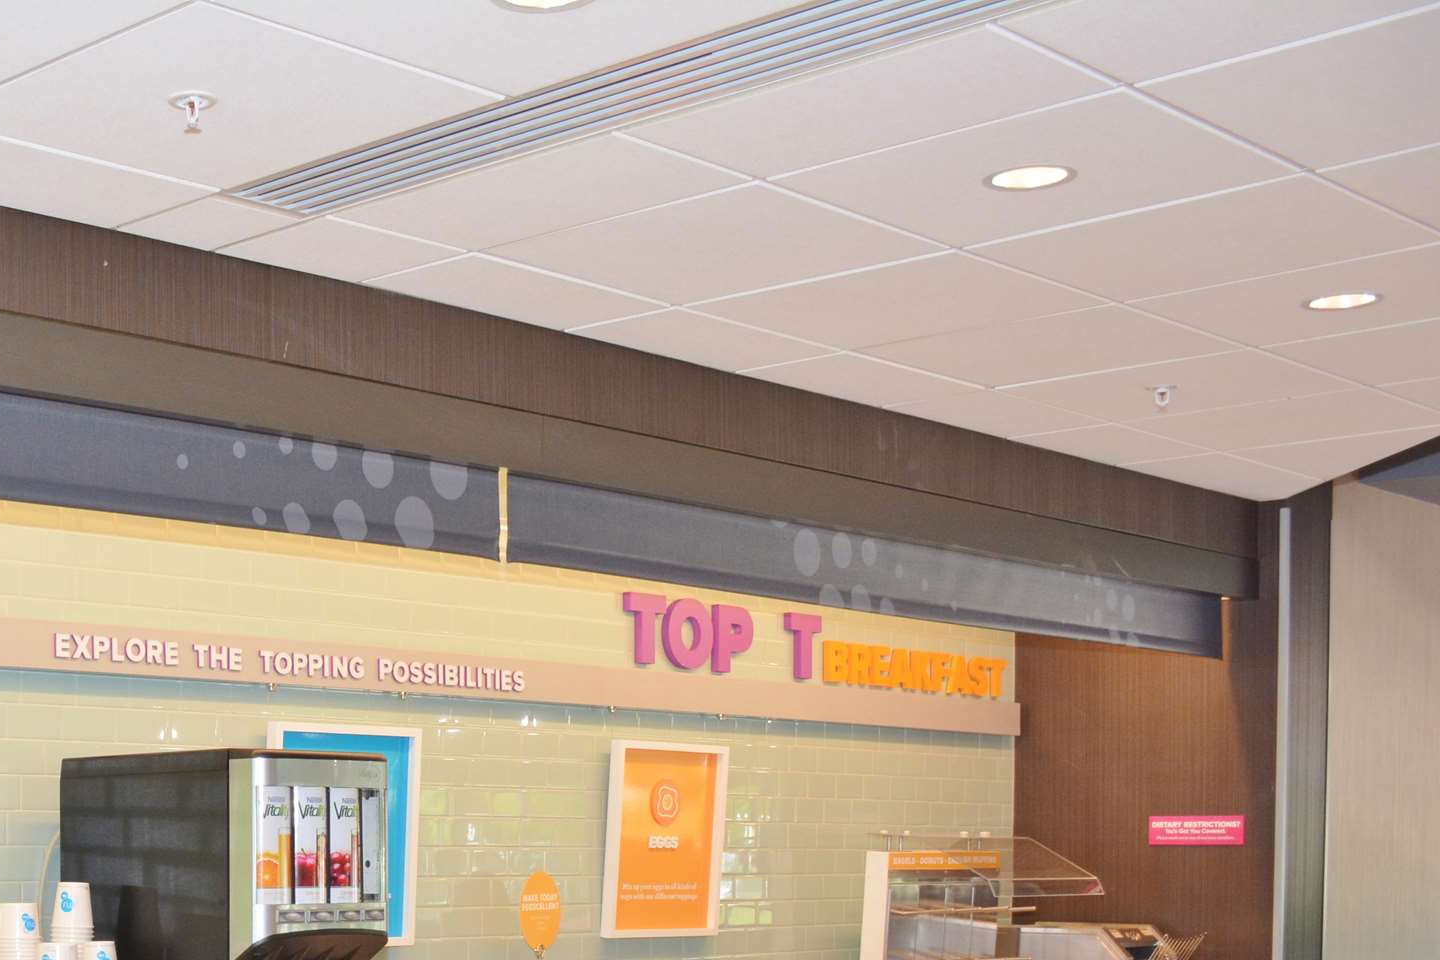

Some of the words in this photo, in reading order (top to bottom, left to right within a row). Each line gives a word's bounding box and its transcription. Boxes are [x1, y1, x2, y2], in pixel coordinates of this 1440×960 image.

[54, 632, 179, 666] EXPLORE
[193, 644, 242, 671] THE
[260, 650, 365, 680] TOPPING
[378, 656, 525, 692] POSSIBILITIES
[623, 592, 754, 674] TOP
[784, 612, 822, 680] T
[823, 640, 1008, 698] BREAKFAST
[648, 834, 680, 849] EGGS
